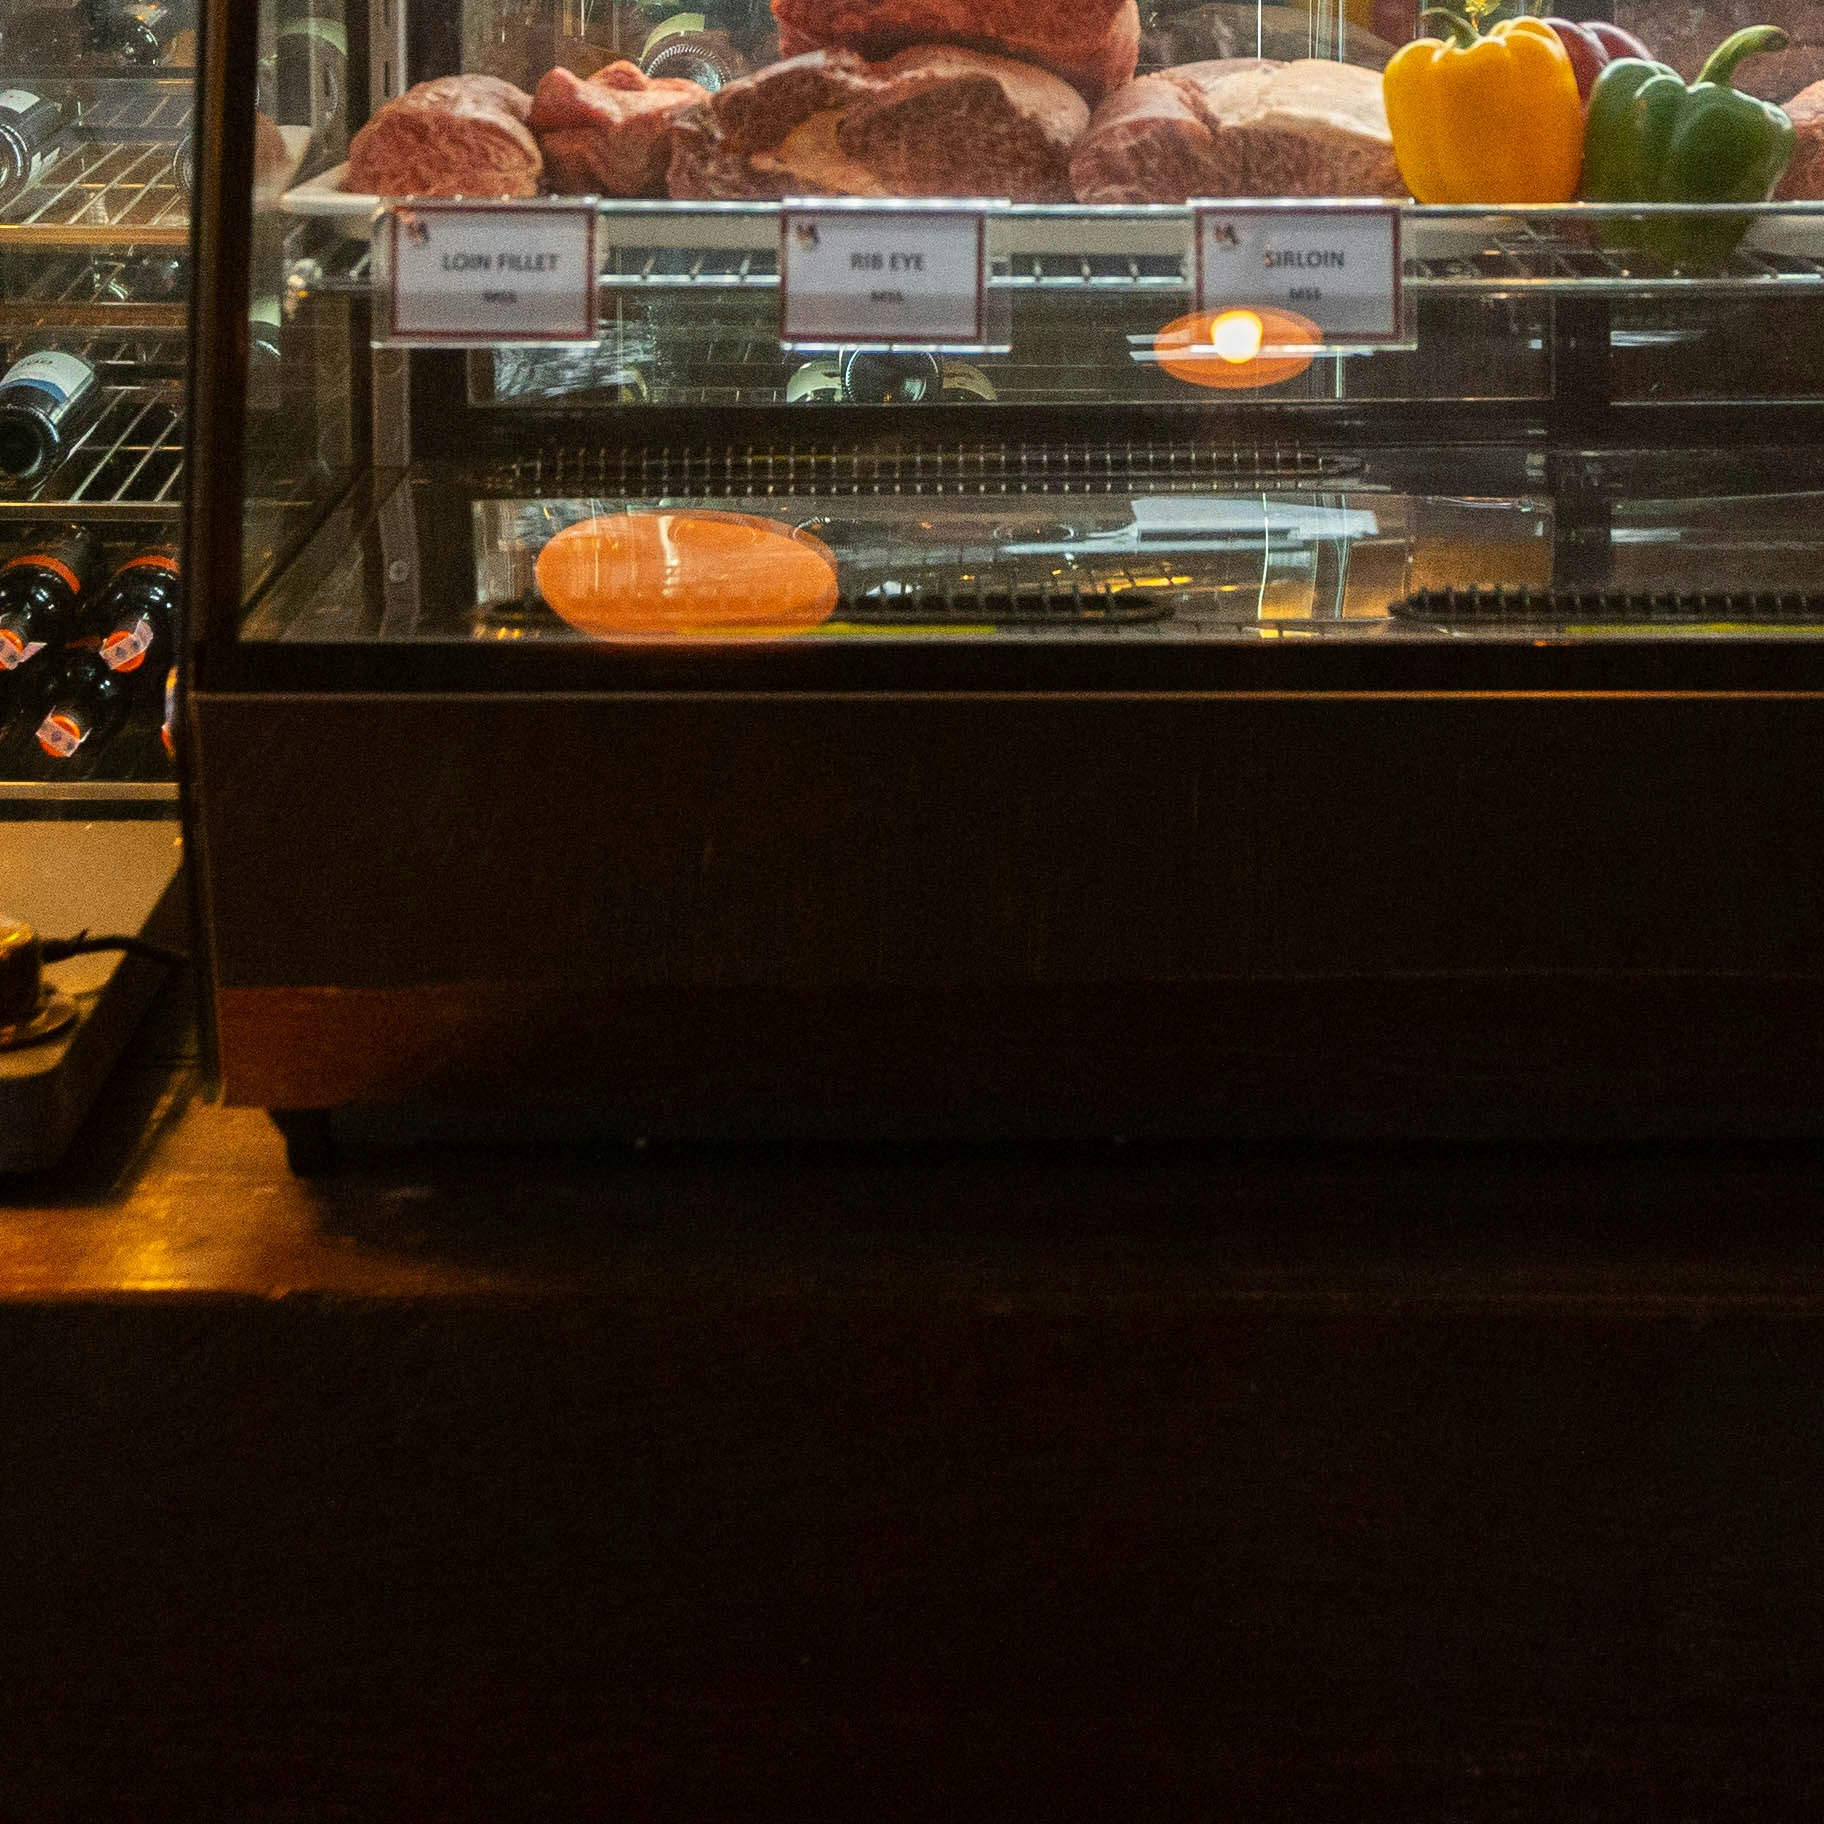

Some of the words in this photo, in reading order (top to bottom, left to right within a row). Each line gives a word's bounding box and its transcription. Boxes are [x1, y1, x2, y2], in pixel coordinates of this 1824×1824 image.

[441, 252, 492, 272] LOIN
[496, 252, 560, 272] FILLET
[850, 252, 884, 271] RIB
[888, 252, 925, 272] EYE
[1263, 249, 1345, 270] SIRLOIN
